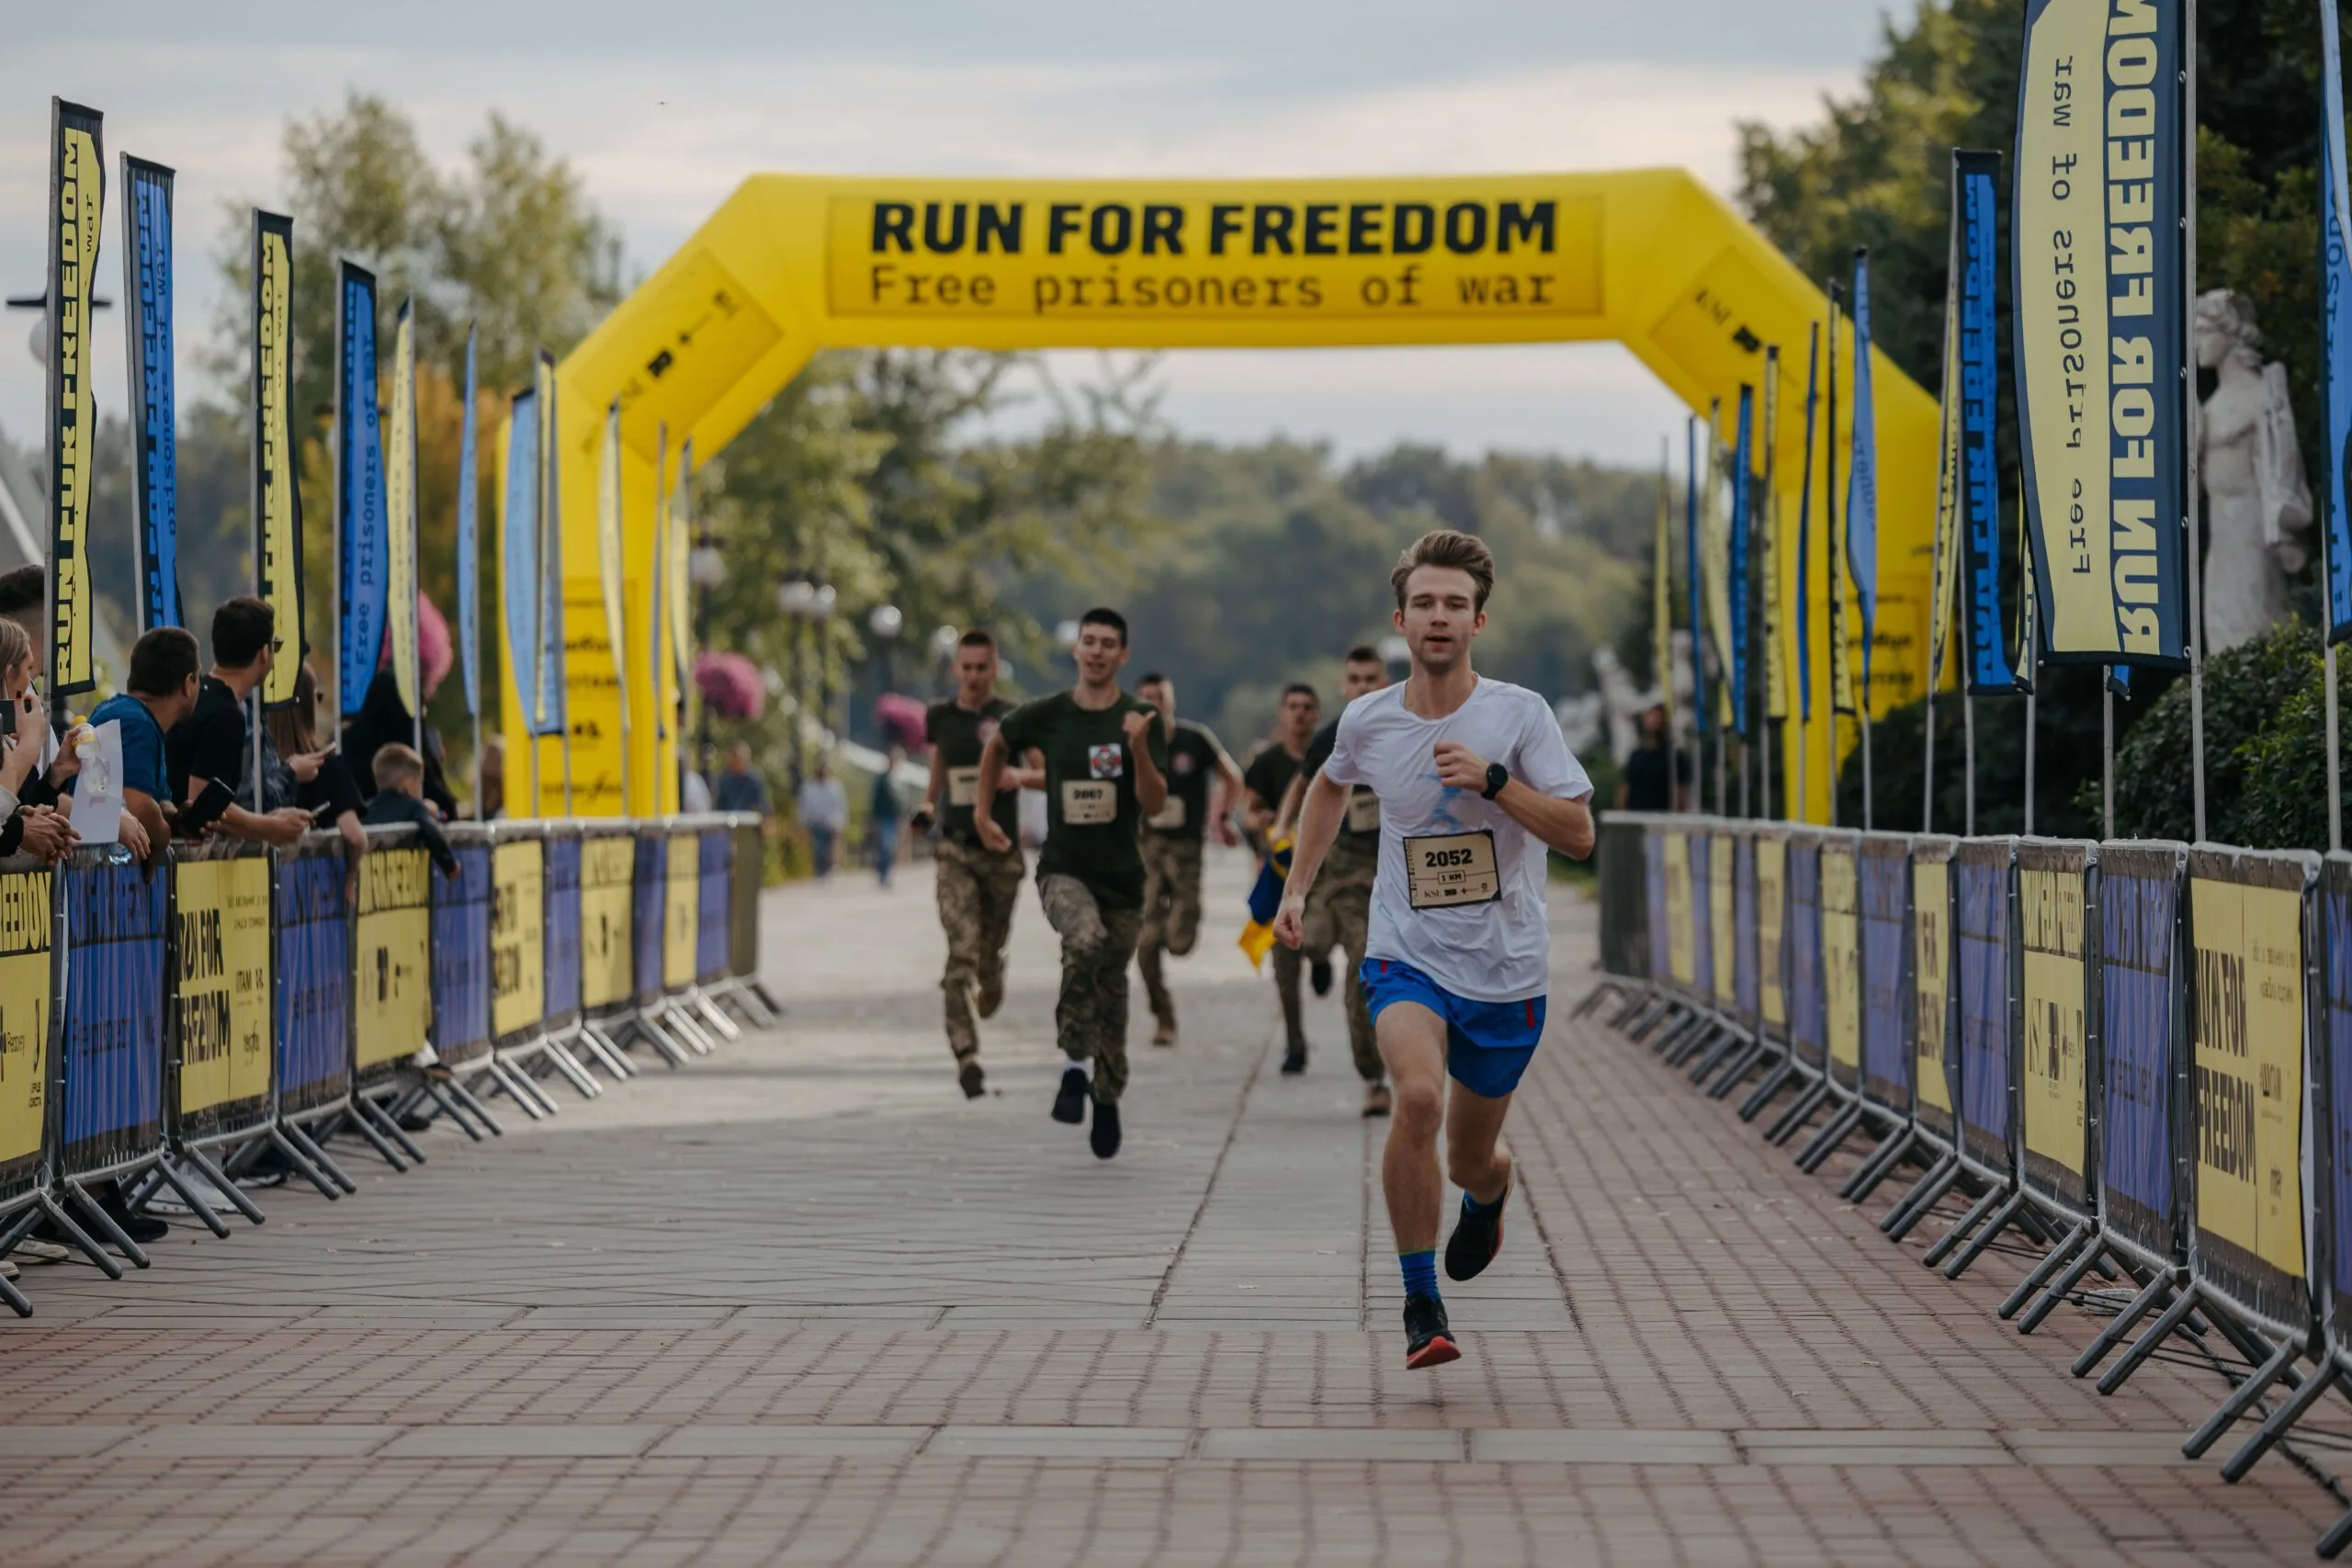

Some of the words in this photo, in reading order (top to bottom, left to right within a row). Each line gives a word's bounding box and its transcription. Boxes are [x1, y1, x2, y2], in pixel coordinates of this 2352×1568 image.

[872, 202, 1023, 254] RUN
[1047, 203, 1186, 255] FOR
[1209, 201, 1556, 255] FREEDOM
[61, 128, 79, 410] FREEDOM
[871, 265, 997, 306] Free
[1034, 265, 1323, 316] prisoners
[1360, 265, 1422, 307] of
[1457, 273, 1556, 307] war
[364, 395, 377, 428] of
[357, 445, 377, 586] prisoners
[56, 558, 74, 686] RUN
[356, 603, 370, 665] Free
[1424, 848, 1474, 868] 2052
[1449, 873, 1462, 881] KM
[200, 908, 224, 980] FOR
[178, 988, 231, 1066] FREEDOM
[2222, 953, 2249, 1058] FOR
[2195, 1065, 2256, 1186] FREEDOM
